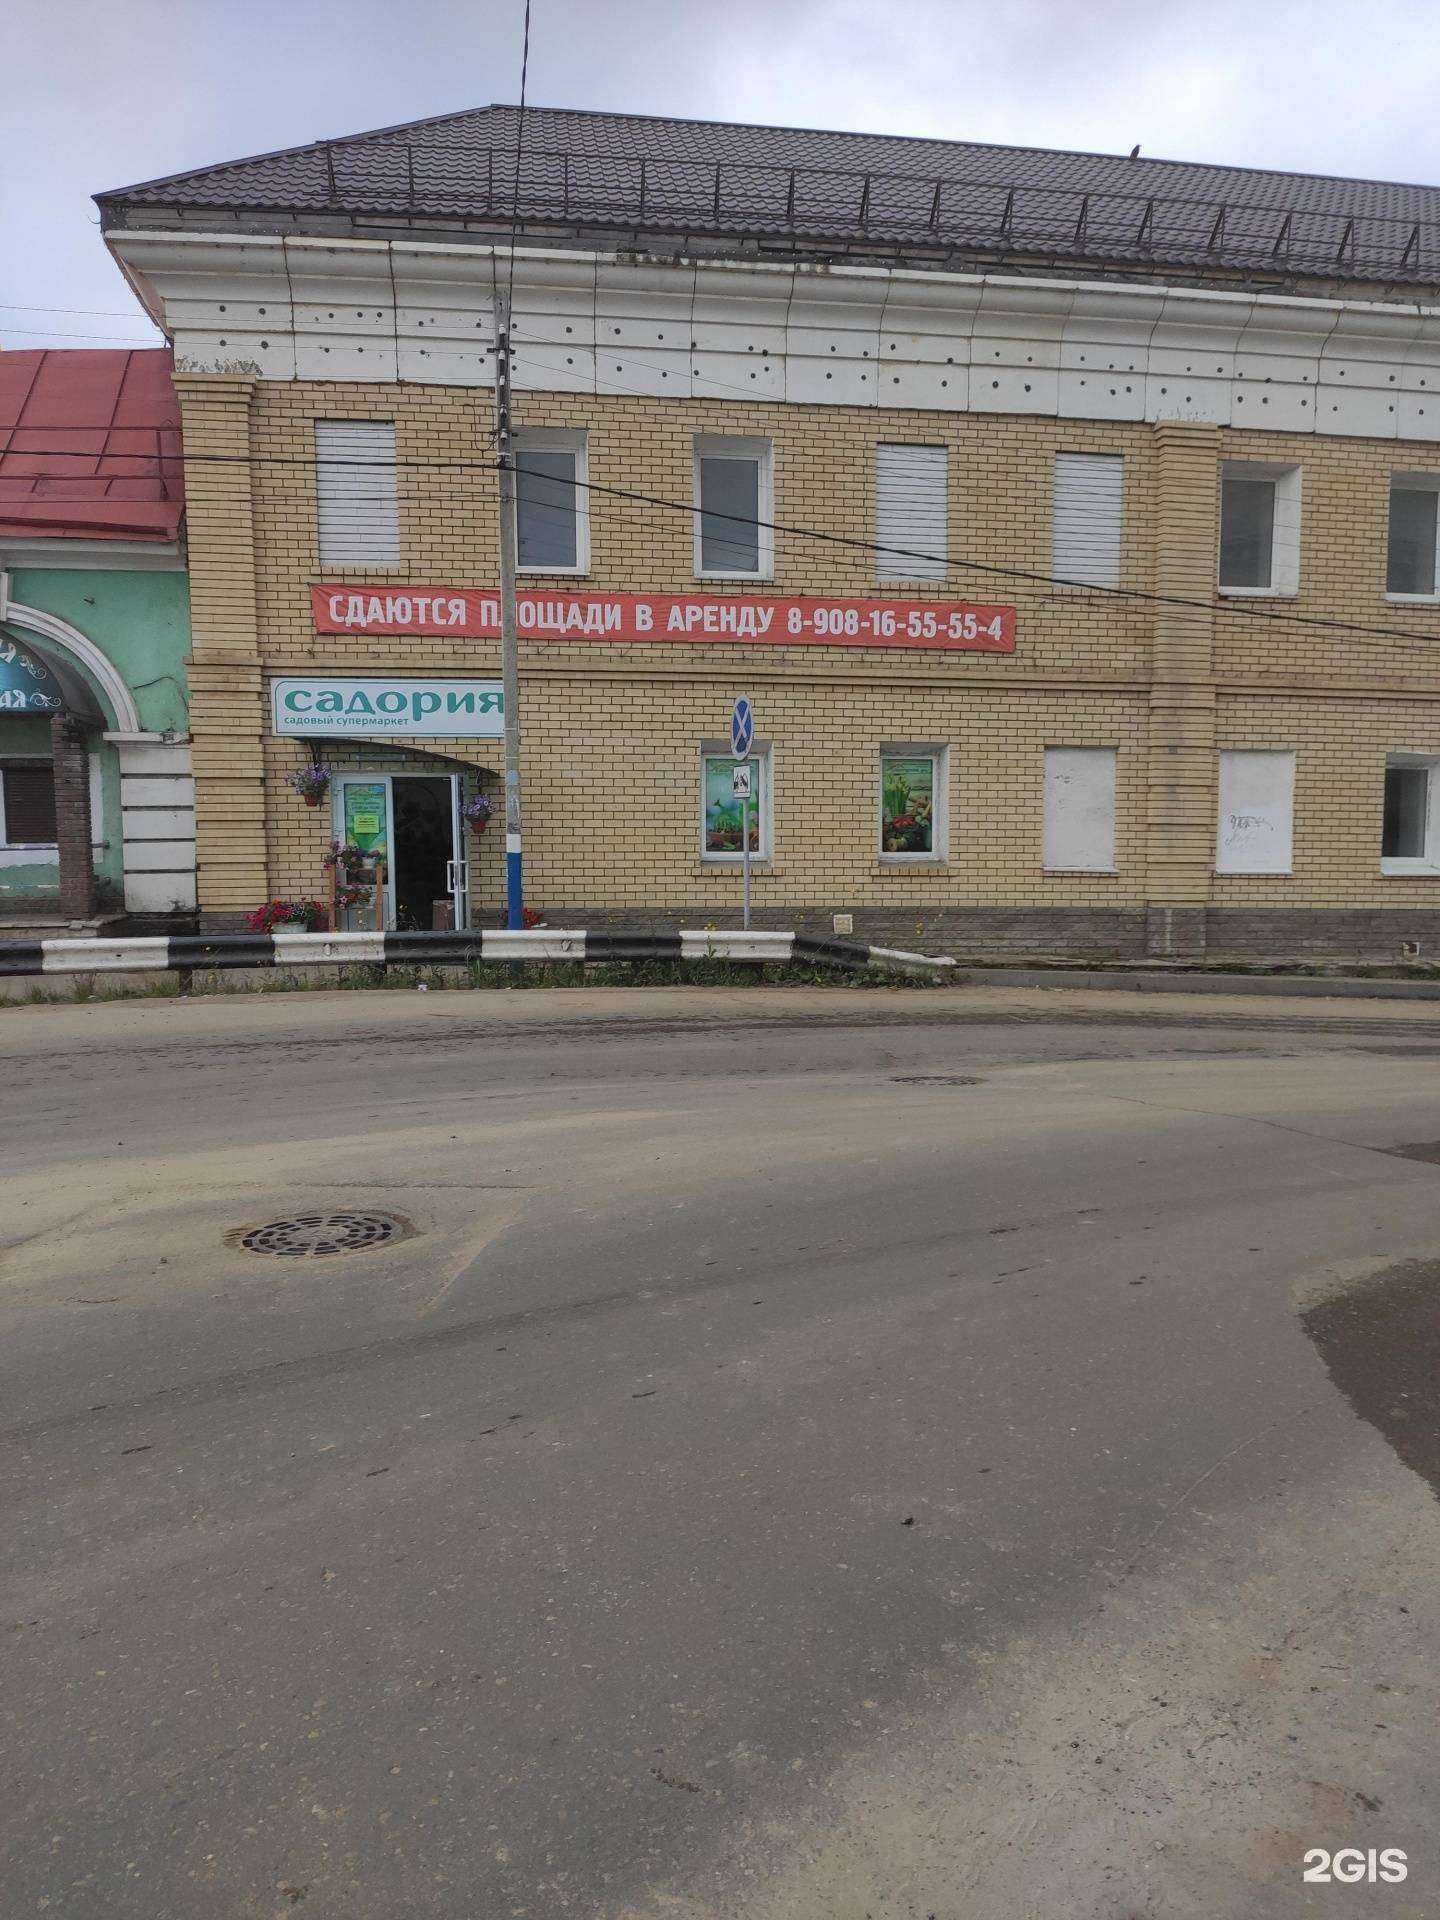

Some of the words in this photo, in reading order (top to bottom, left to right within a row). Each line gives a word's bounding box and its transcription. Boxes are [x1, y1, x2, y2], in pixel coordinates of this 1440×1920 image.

[328, 595, 466, 627] СДАЮТСЯ
[481, 600, 621, 634] ПОЩАДИ
[635, 604, 654, 630] В
[667, 605, 774, 637] АРЕНДУ
[787, 607, 1002, 641] 8-908-16-55-55-4
[284, 690, 504, 721] садория
[284, 715, 333, 725] садовый
[336, 717, 409, 727] супермаркет
